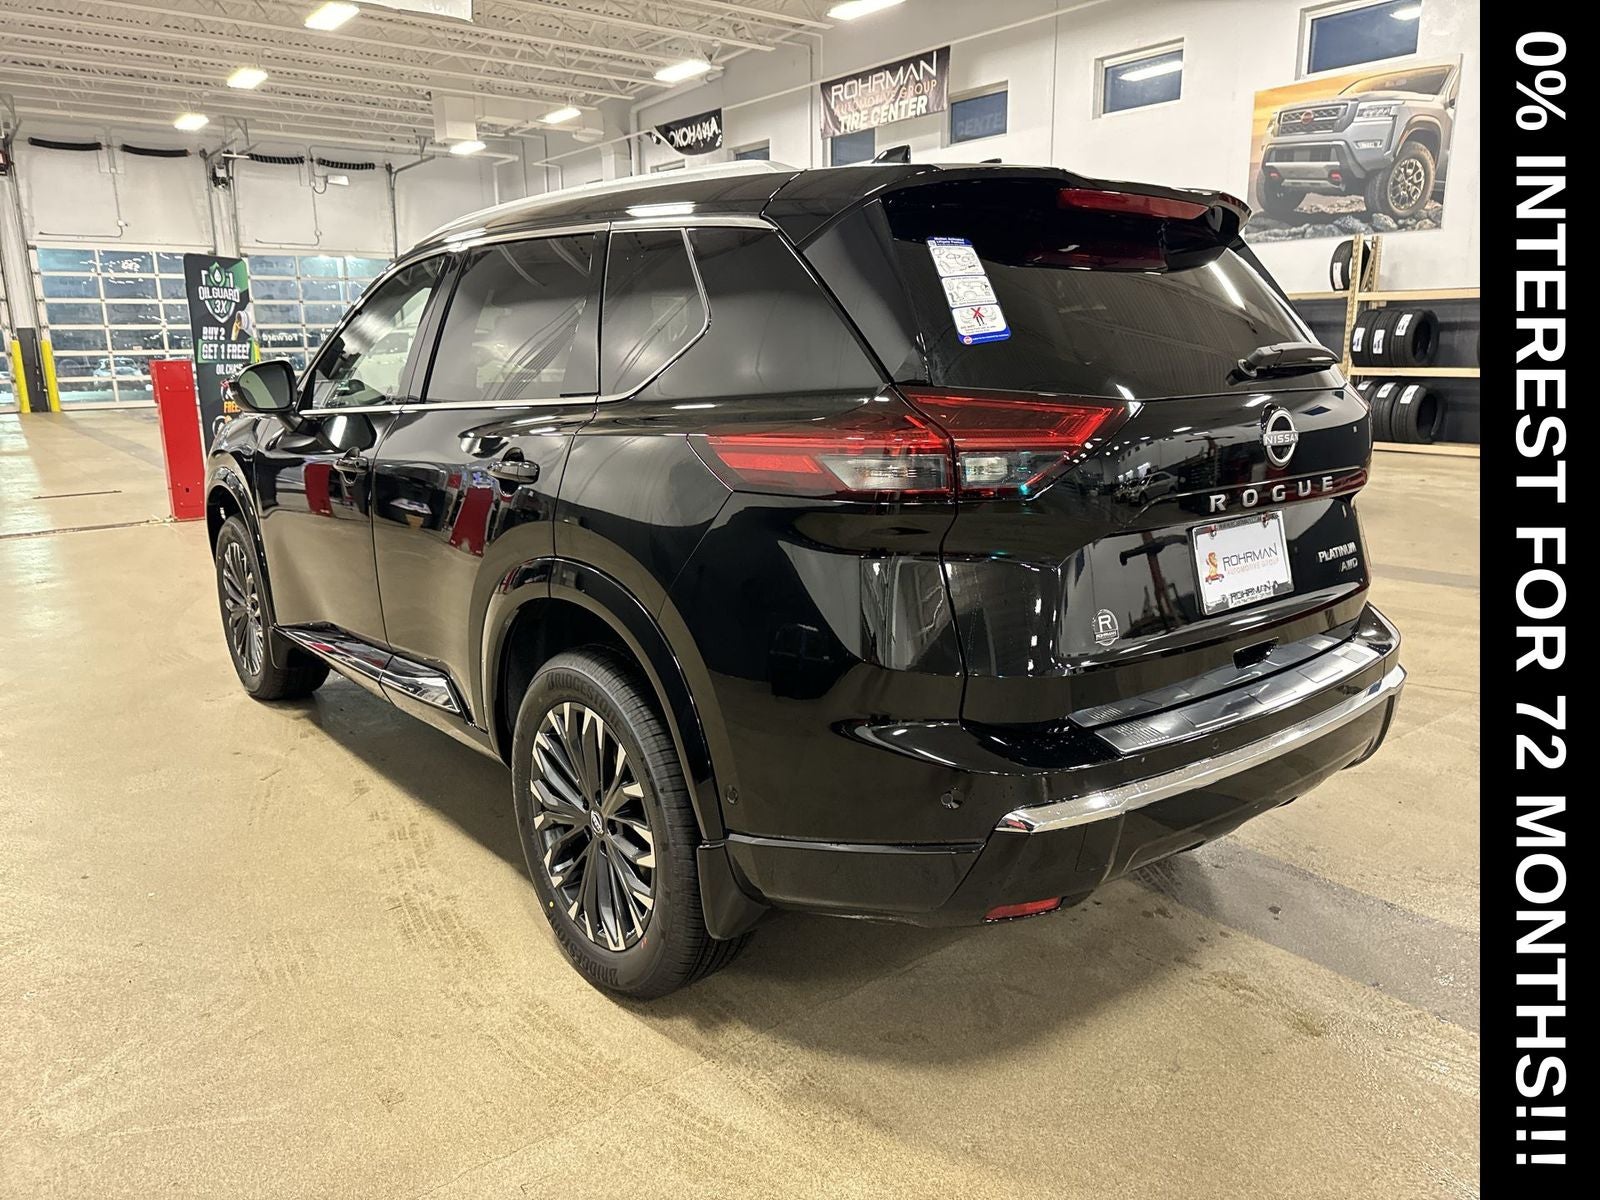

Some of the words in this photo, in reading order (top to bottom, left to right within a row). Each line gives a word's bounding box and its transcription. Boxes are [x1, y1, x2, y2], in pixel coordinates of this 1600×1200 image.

[830, 51, 938, 109] ROHRMAN
[900, 79, 938, 100] GROUP
[838, 109, 868, 133] TIRE
[870, 94, 928, 124] CENTER
[214, 300, 227, 314] 3X
[202, 326, 218, 341] BUY
[219, 327, 226, 341] 2
[202, 343, 218, 360] GET
[220, 343, 225, 360] 1
[226, 343, 250, 360] FREE!
[215, 363, 225, 375] OIL
[1265, 432, 1298, 446] NISSAN
[1209, 475, 1334, 513] ROGUE
[1222, 543, 1278, 572] ROHRMAN
[1318, 541, 1357, 563] PLATINUM
[1340, 557, 1358, 573] AWD
[1098, 614, 1112, 633] R
